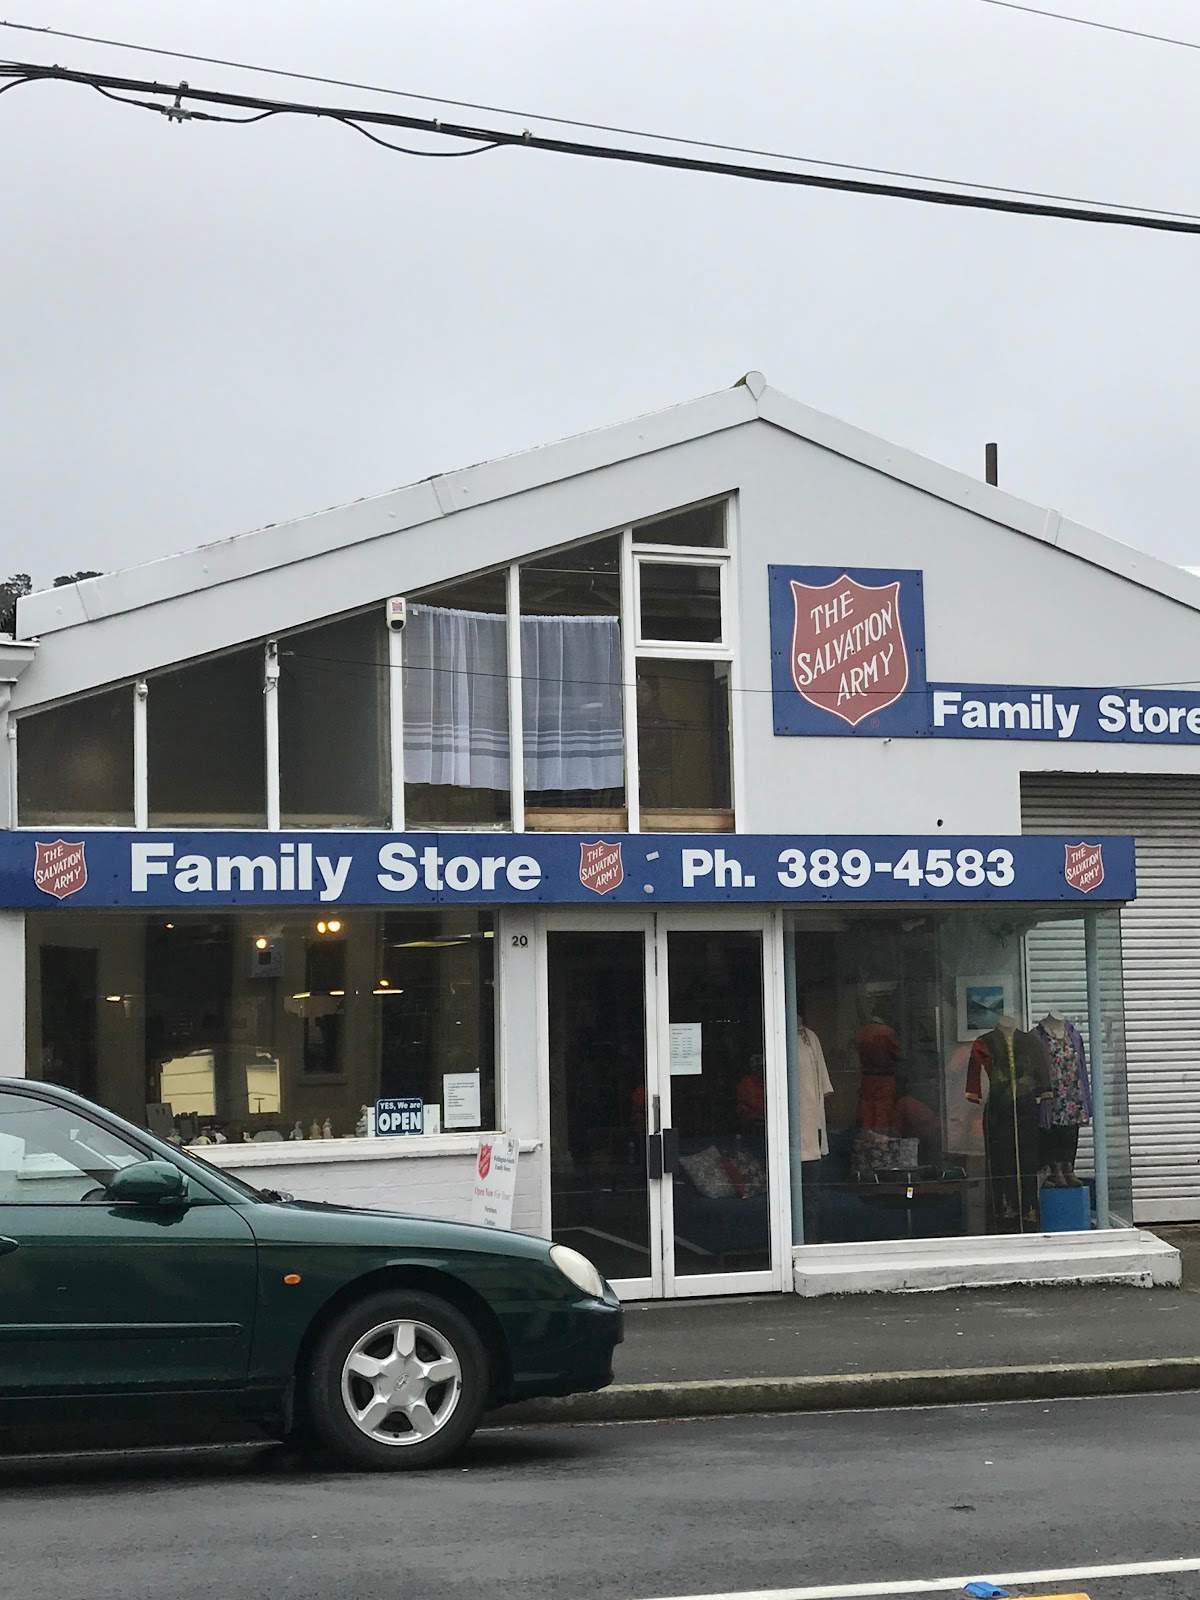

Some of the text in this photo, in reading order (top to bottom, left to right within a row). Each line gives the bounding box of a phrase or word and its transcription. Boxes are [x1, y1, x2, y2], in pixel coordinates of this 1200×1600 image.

[810, 590, 854, 635] THE
[797, 600, 893, 686] SALVATION
[836, 643, 894, 706] ARMY
[932, 691, 1080, 739] Family
[36, 849, 82, 885] SALVATION
[43, 845, 64, 864] THE
[581, 849, 619, 881] SALVATION
[586, 845, 604, 863] THE
[681, 849, 1015, 888] Ph. 389-4583
[1066, 850, 1100, 881] SALVATION
[1071, 847, 1086, 864] THE
[53, 865, 82, 892] ARMY
[130, 842, 542, 902] Family Store
[595, 865, 619, 889] ARMY
[1079, 864, 1100, 887] ARMY
[511, 935, 529, 947] 20
[380, 1101, 396, 1110] YES,
[397, 1101, 409, 1109] We
[378, 1111, 422, 1132] OPEN
